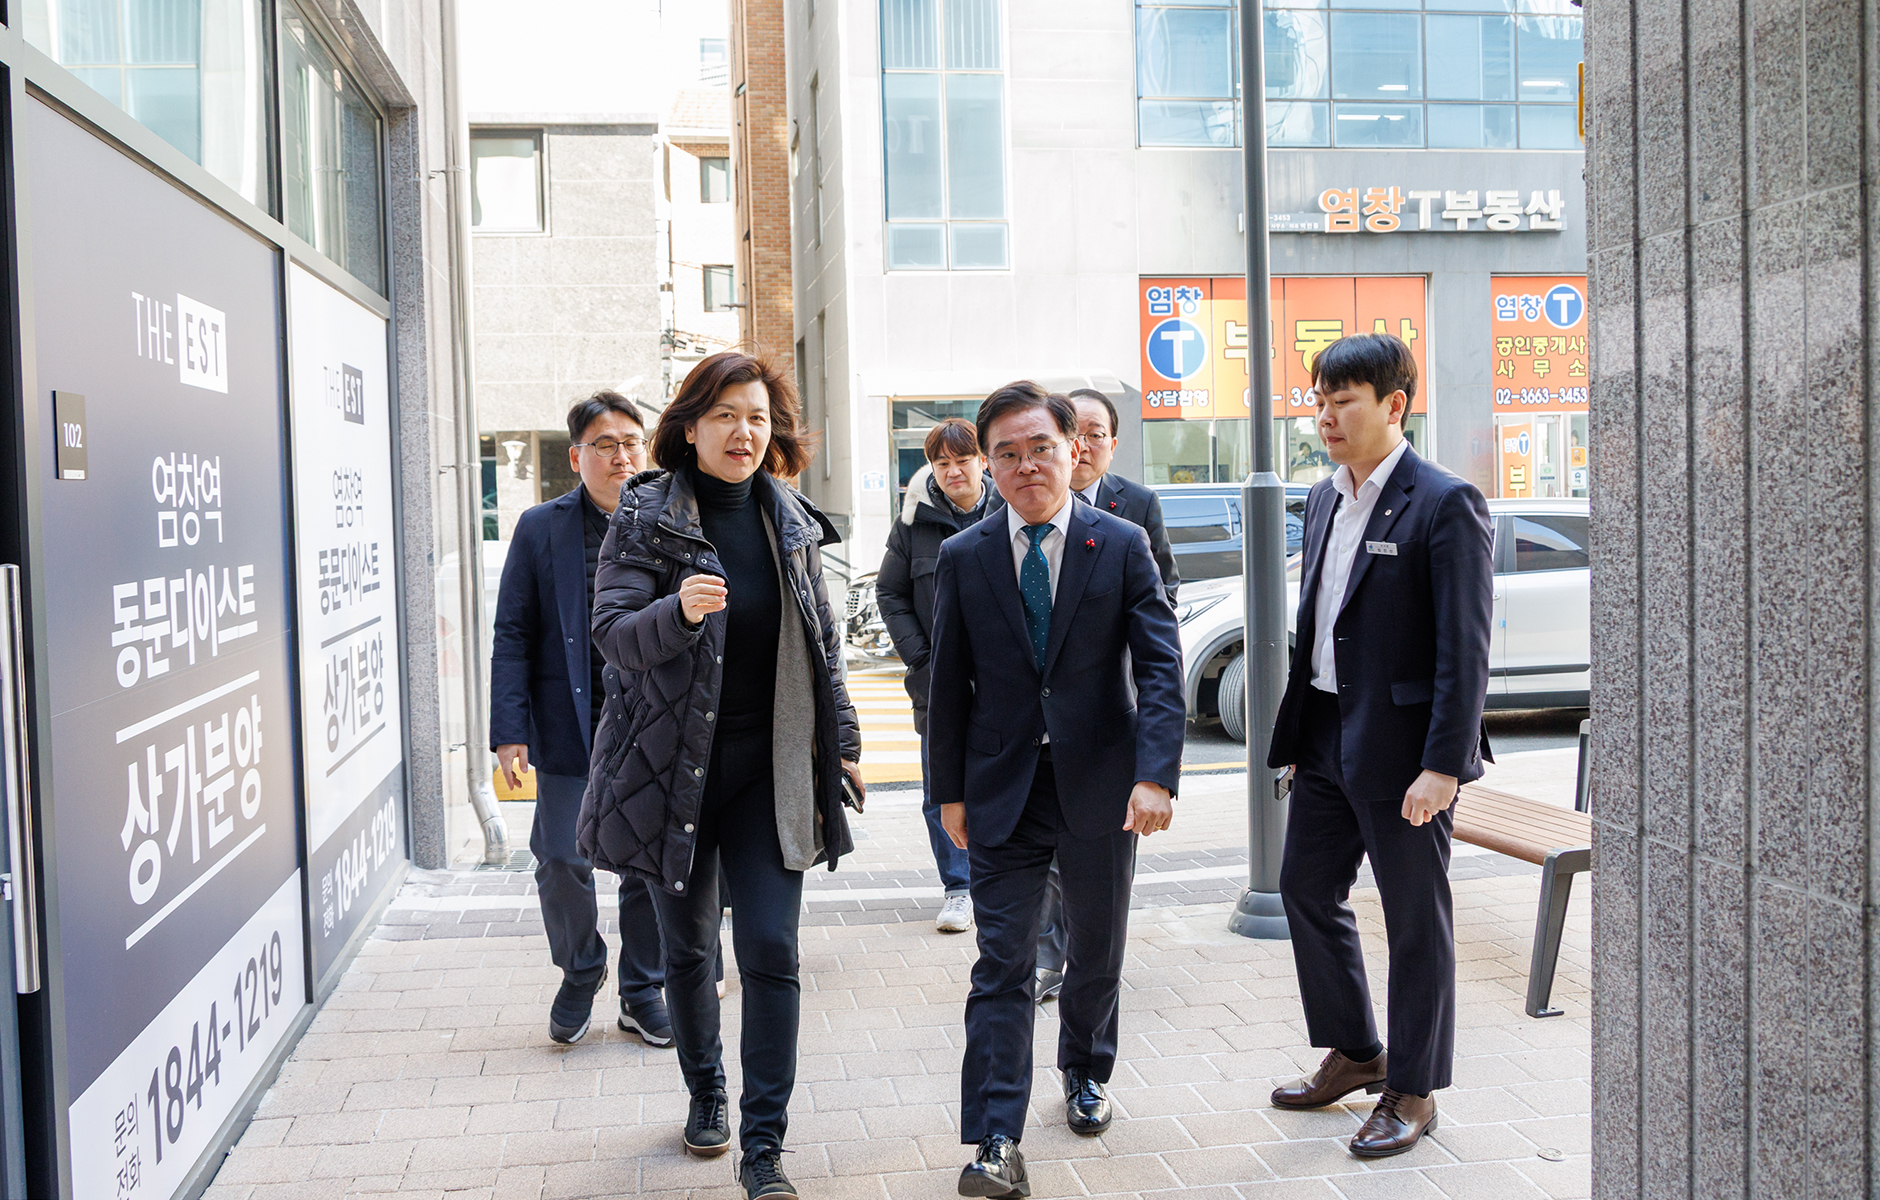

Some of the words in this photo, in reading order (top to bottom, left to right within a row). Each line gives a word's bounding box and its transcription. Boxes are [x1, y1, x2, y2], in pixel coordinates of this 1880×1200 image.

[131, 291, 174, 365] THE
[185, 312, 220, 377] EST
[1146, 286, 1203, 317] 염창
[1495, 294, 1543, 322] 염창
[1495, 335, 1587, 357] 공인중개사
[323, 366, 341, 410] THE
[344, 373, 363, 416] EST
[1495, 386, 1588, 405] 02-3663-3453
[63, 422, 83, 448] 102
[152, 452, 223, 548] 염창역
[333, 466, 364, 529] 염창역
[318, 541, 381, 616] 동문디이스트
[111, 564, 259, 688] 동문디이스트
[323, 631, 384, 753] 상가분양
[120, 693, 264, 906] 상가분양
[321, 868, 334, 905] 문의
[335, 796, 396, 921] 1844-1219
[322, 902, 335, 939] 전화
[114, 1092, 139, 1159] 문의
[147, 930, 283, 1167] 1844-1219
